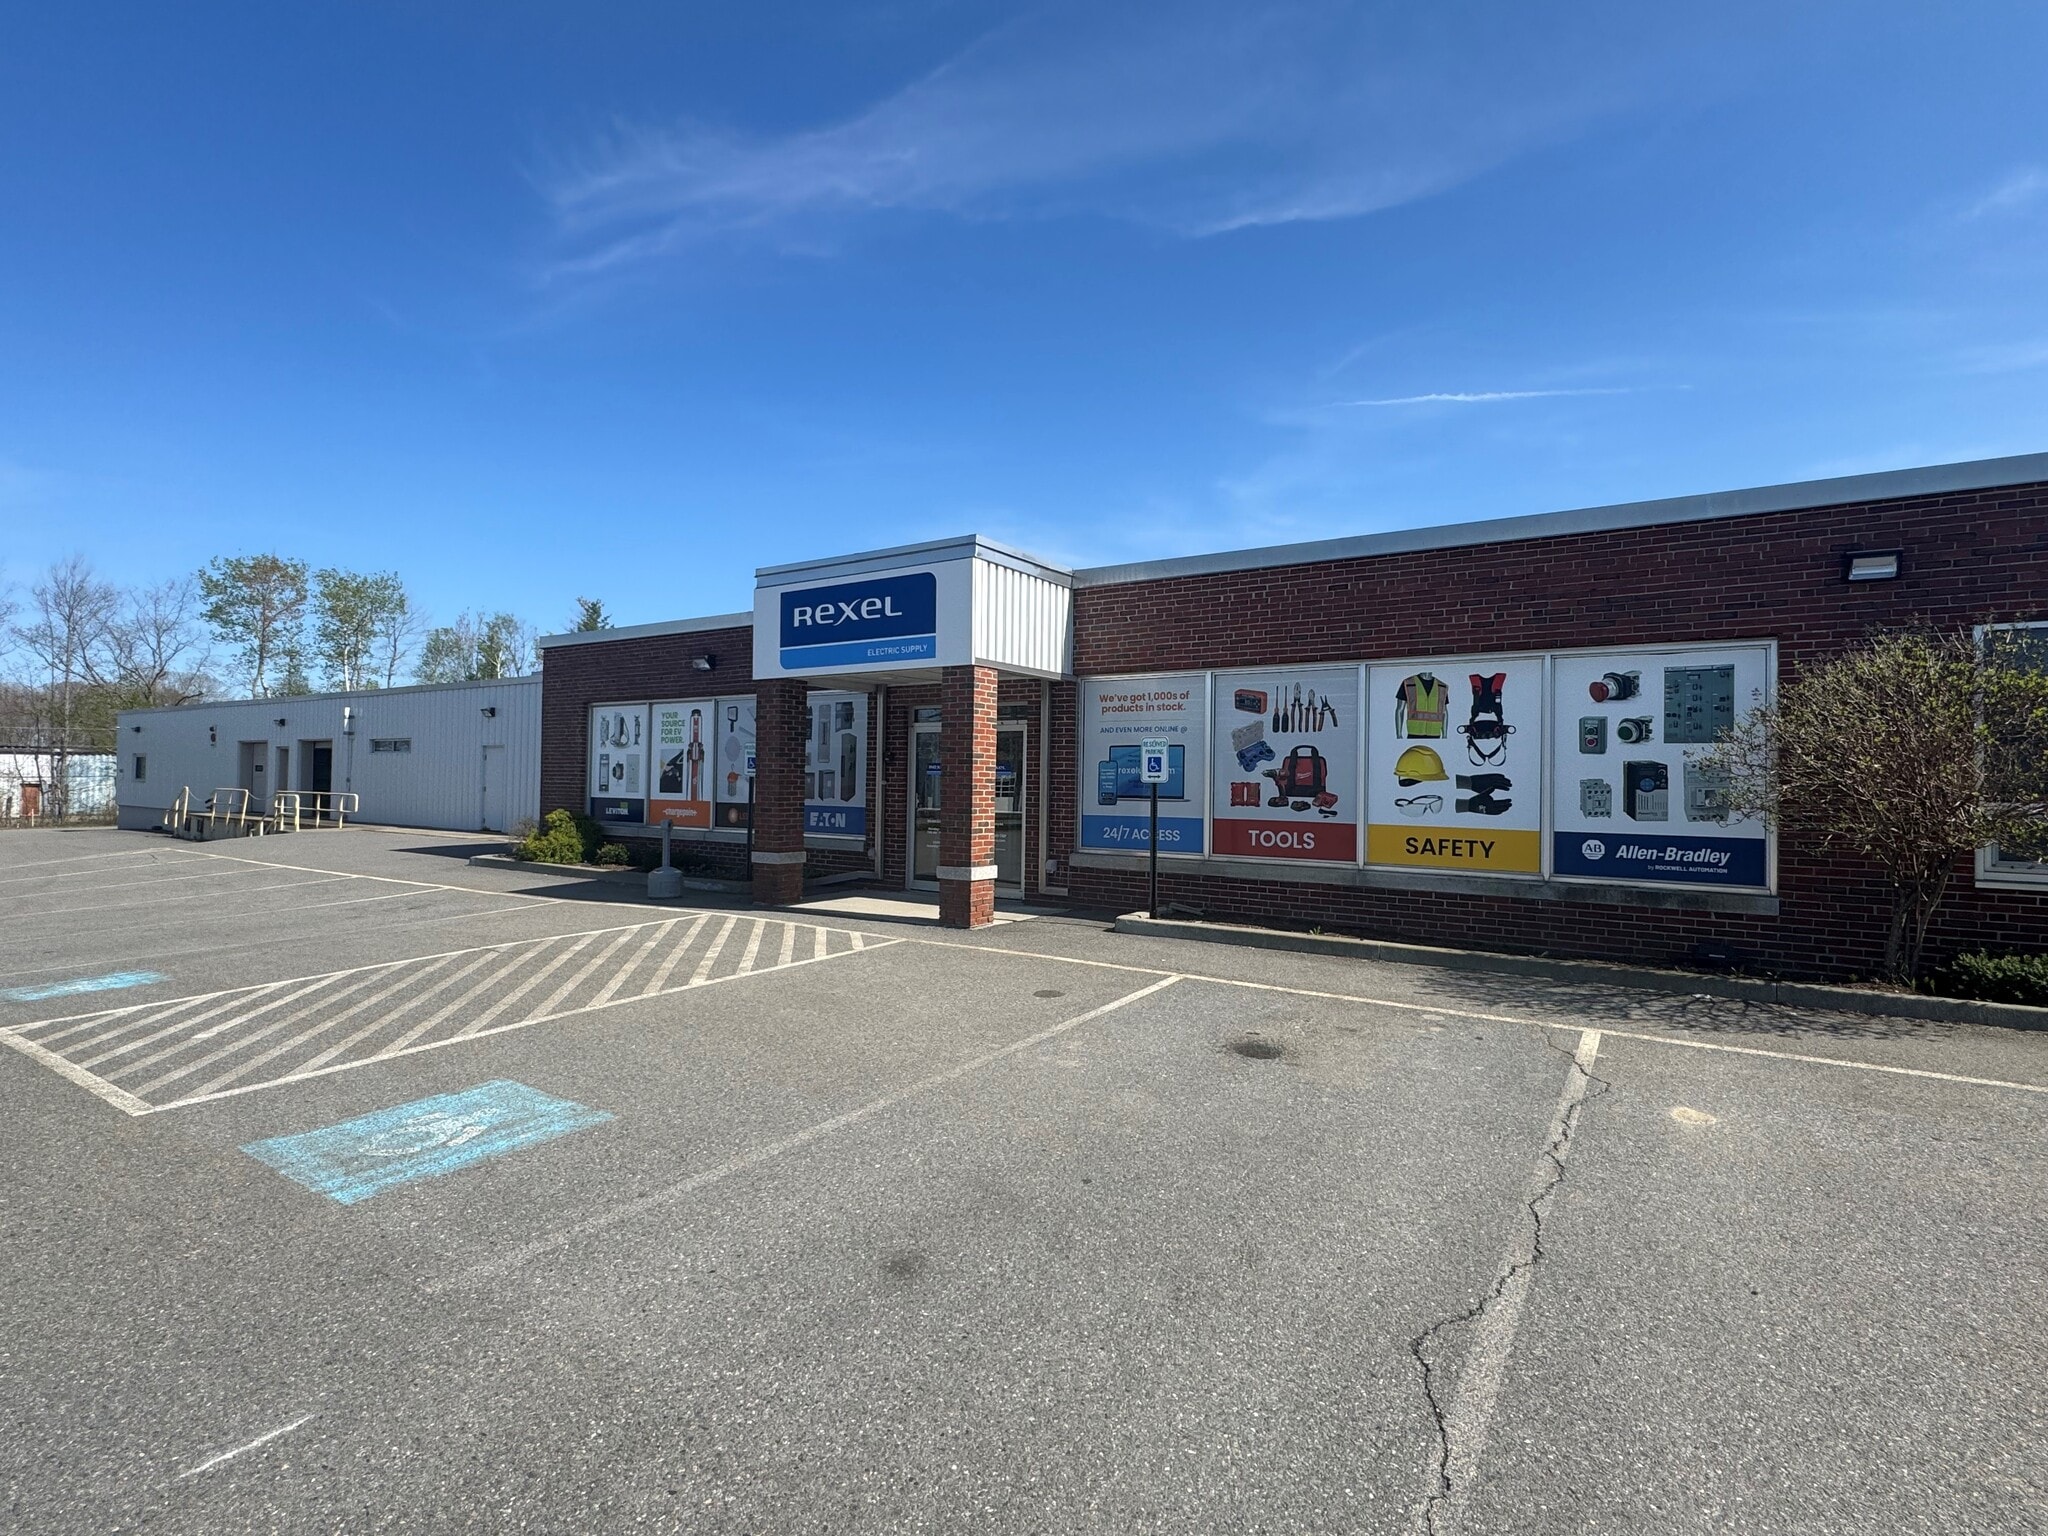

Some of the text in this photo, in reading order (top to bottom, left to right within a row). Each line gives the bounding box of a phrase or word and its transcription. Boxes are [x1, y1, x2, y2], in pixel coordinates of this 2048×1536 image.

[867, 644, 928, 656] ELECTRIC SUPPLY
[1099, 690, 1190, 704] We've got 1,000s of
[1101, 702, 1186, 715] products in stock.
[605, 807, 629, 815] LEVITON
[809, 811, 846, 828] EATON
[1103, 824, 1181, 842] 24/7 ACESS
[1248, 829, 1316, 850] TOOLS
[1405, 836, 1496, 860] SAFETY
[1584, 843, 1602, 854] AB
[1615, 844, 1731, 866] Allen-Bradley
[1688, 866, 1728, 874] AUTOMATION
